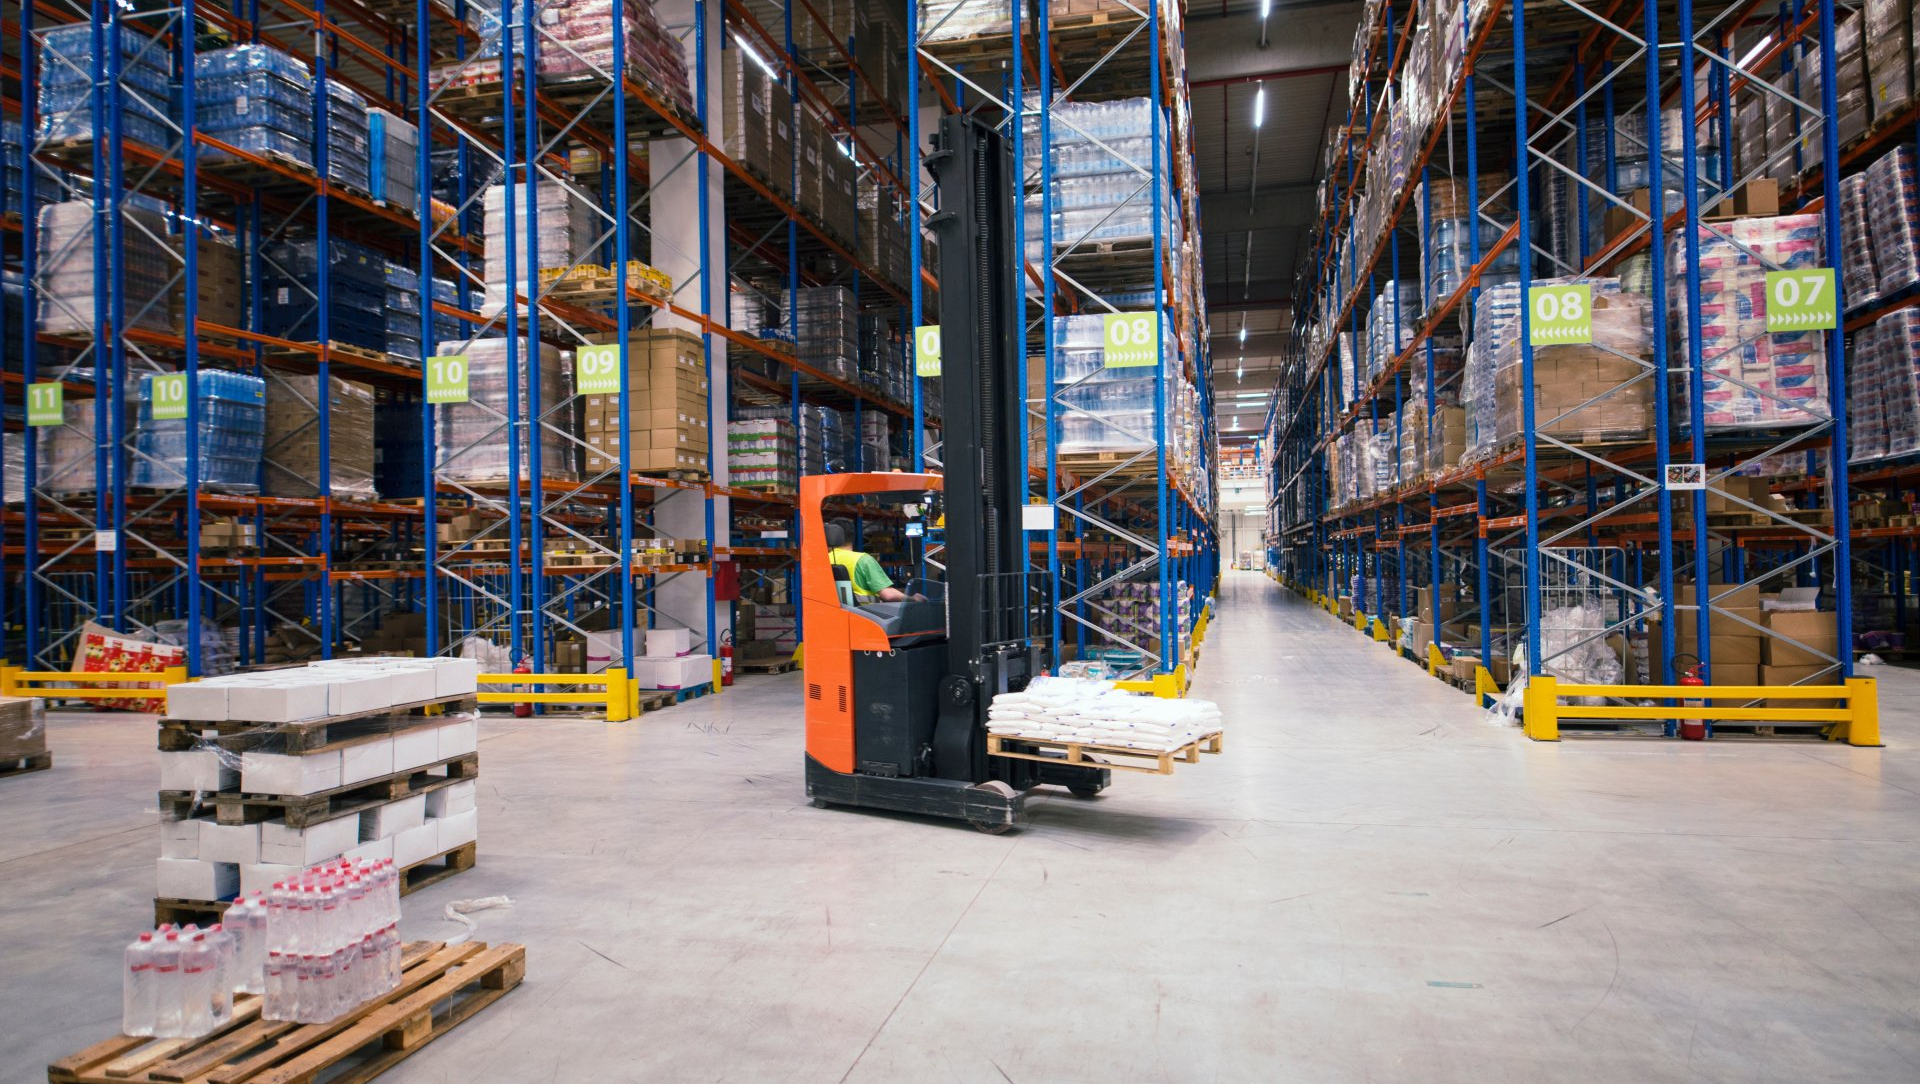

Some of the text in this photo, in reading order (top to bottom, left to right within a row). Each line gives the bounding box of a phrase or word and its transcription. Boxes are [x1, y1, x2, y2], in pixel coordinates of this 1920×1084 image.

[1775, 275, 1826, 307] 07
[1536, 292, 1584, 322] 08
[922, 331, 940, 356] 0
[1110, 318, 1152, 347] 08
[433, 361, 464, 384] 10
[582, 350, 615, 375] 09
[32, 387, 56, 408] 11
[157, 379, 183, 401] 10
